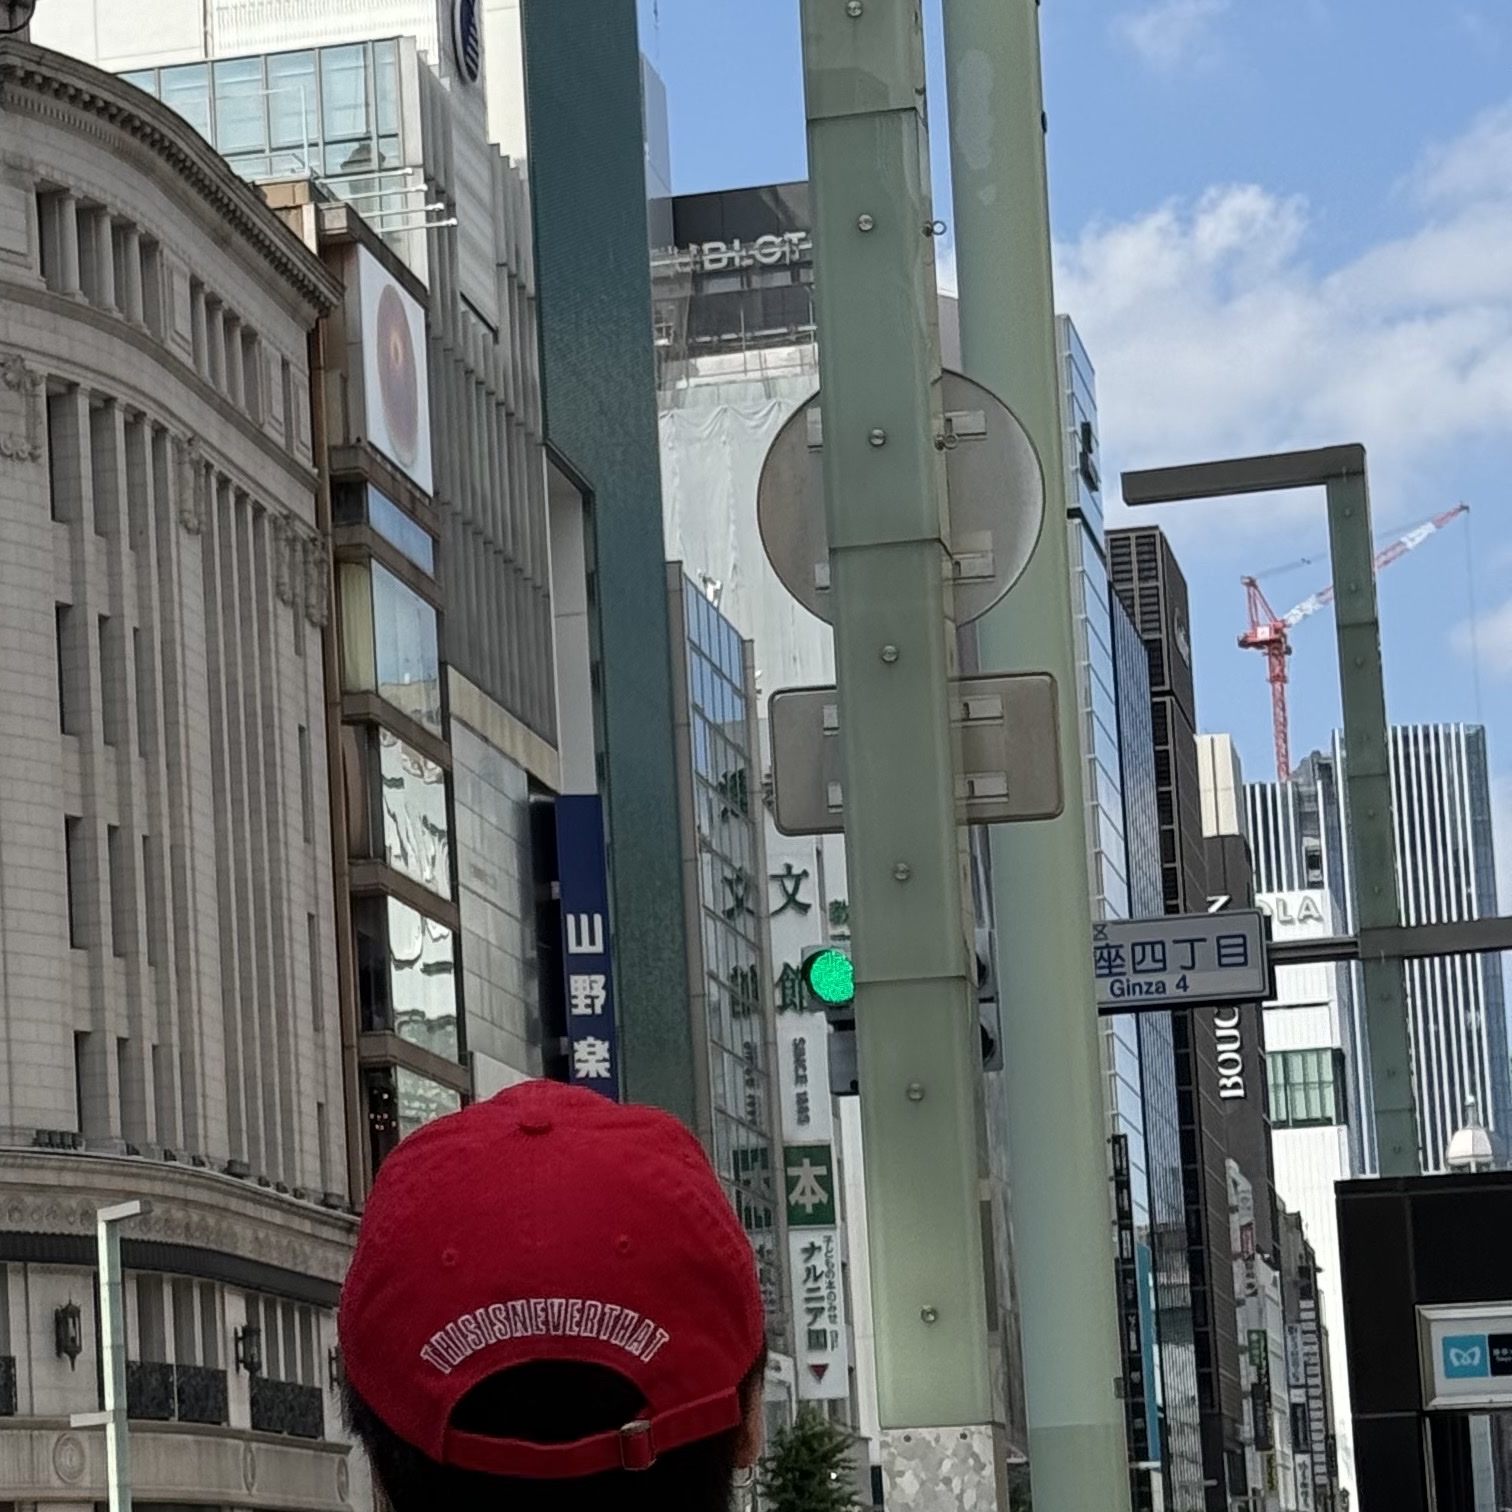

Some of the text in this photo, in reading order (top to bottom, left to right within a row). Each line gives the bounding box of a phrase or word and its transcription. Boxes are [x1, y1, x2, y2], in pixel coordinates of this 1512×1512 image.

[1093, 934, 1249, 979] 座四丁目
[1109, 974, 1190, 998] Ginza 4
[786, 1157, 830, 1215] 本
[420, 1297, 670, 1375] THISISNEVERTHAT
